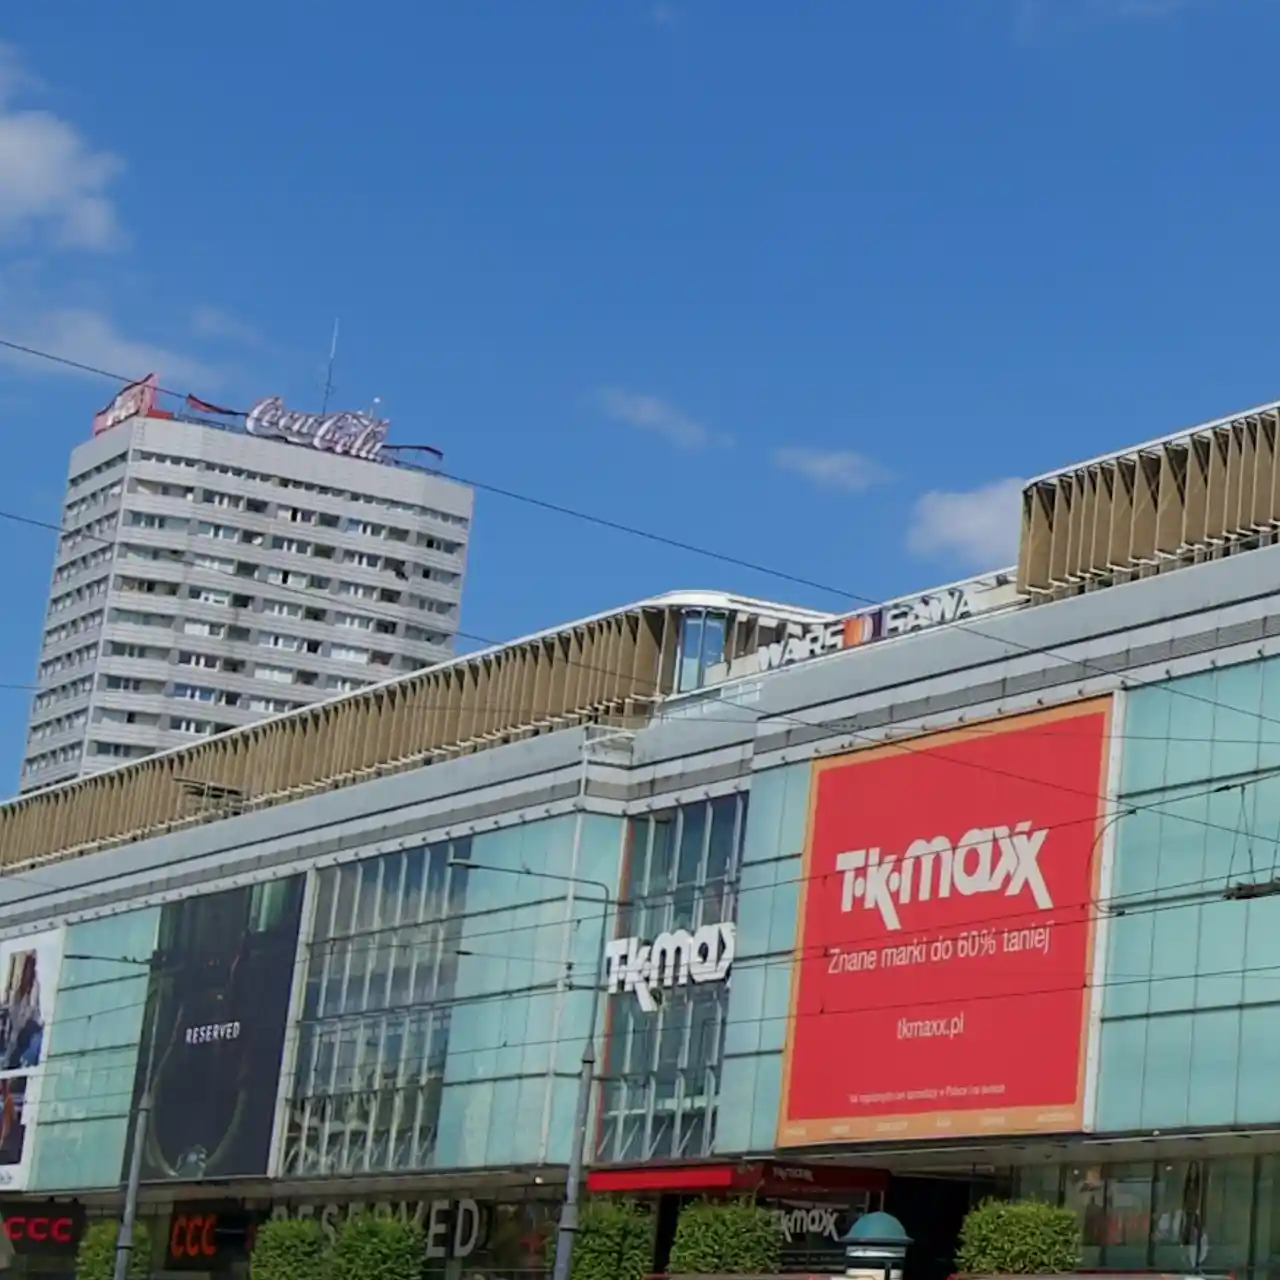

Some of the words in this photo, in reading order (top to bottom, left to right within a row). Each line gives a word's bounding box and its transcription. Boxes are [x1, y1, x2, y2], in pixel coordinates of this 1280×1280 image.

[828, 948, 877, 974] Znane
[881, 937, 926, 969] marki
[930, 935, 953, 961] do
[957, 927, 996, 958] 60%
[185, 1021, 240, 1044] RESERVED
[897, 1010, 964, 1040] tkmaxx.pl
[4, 1216, 73, 1242] CCC
[170, 1214, 217, 1258] CCC
